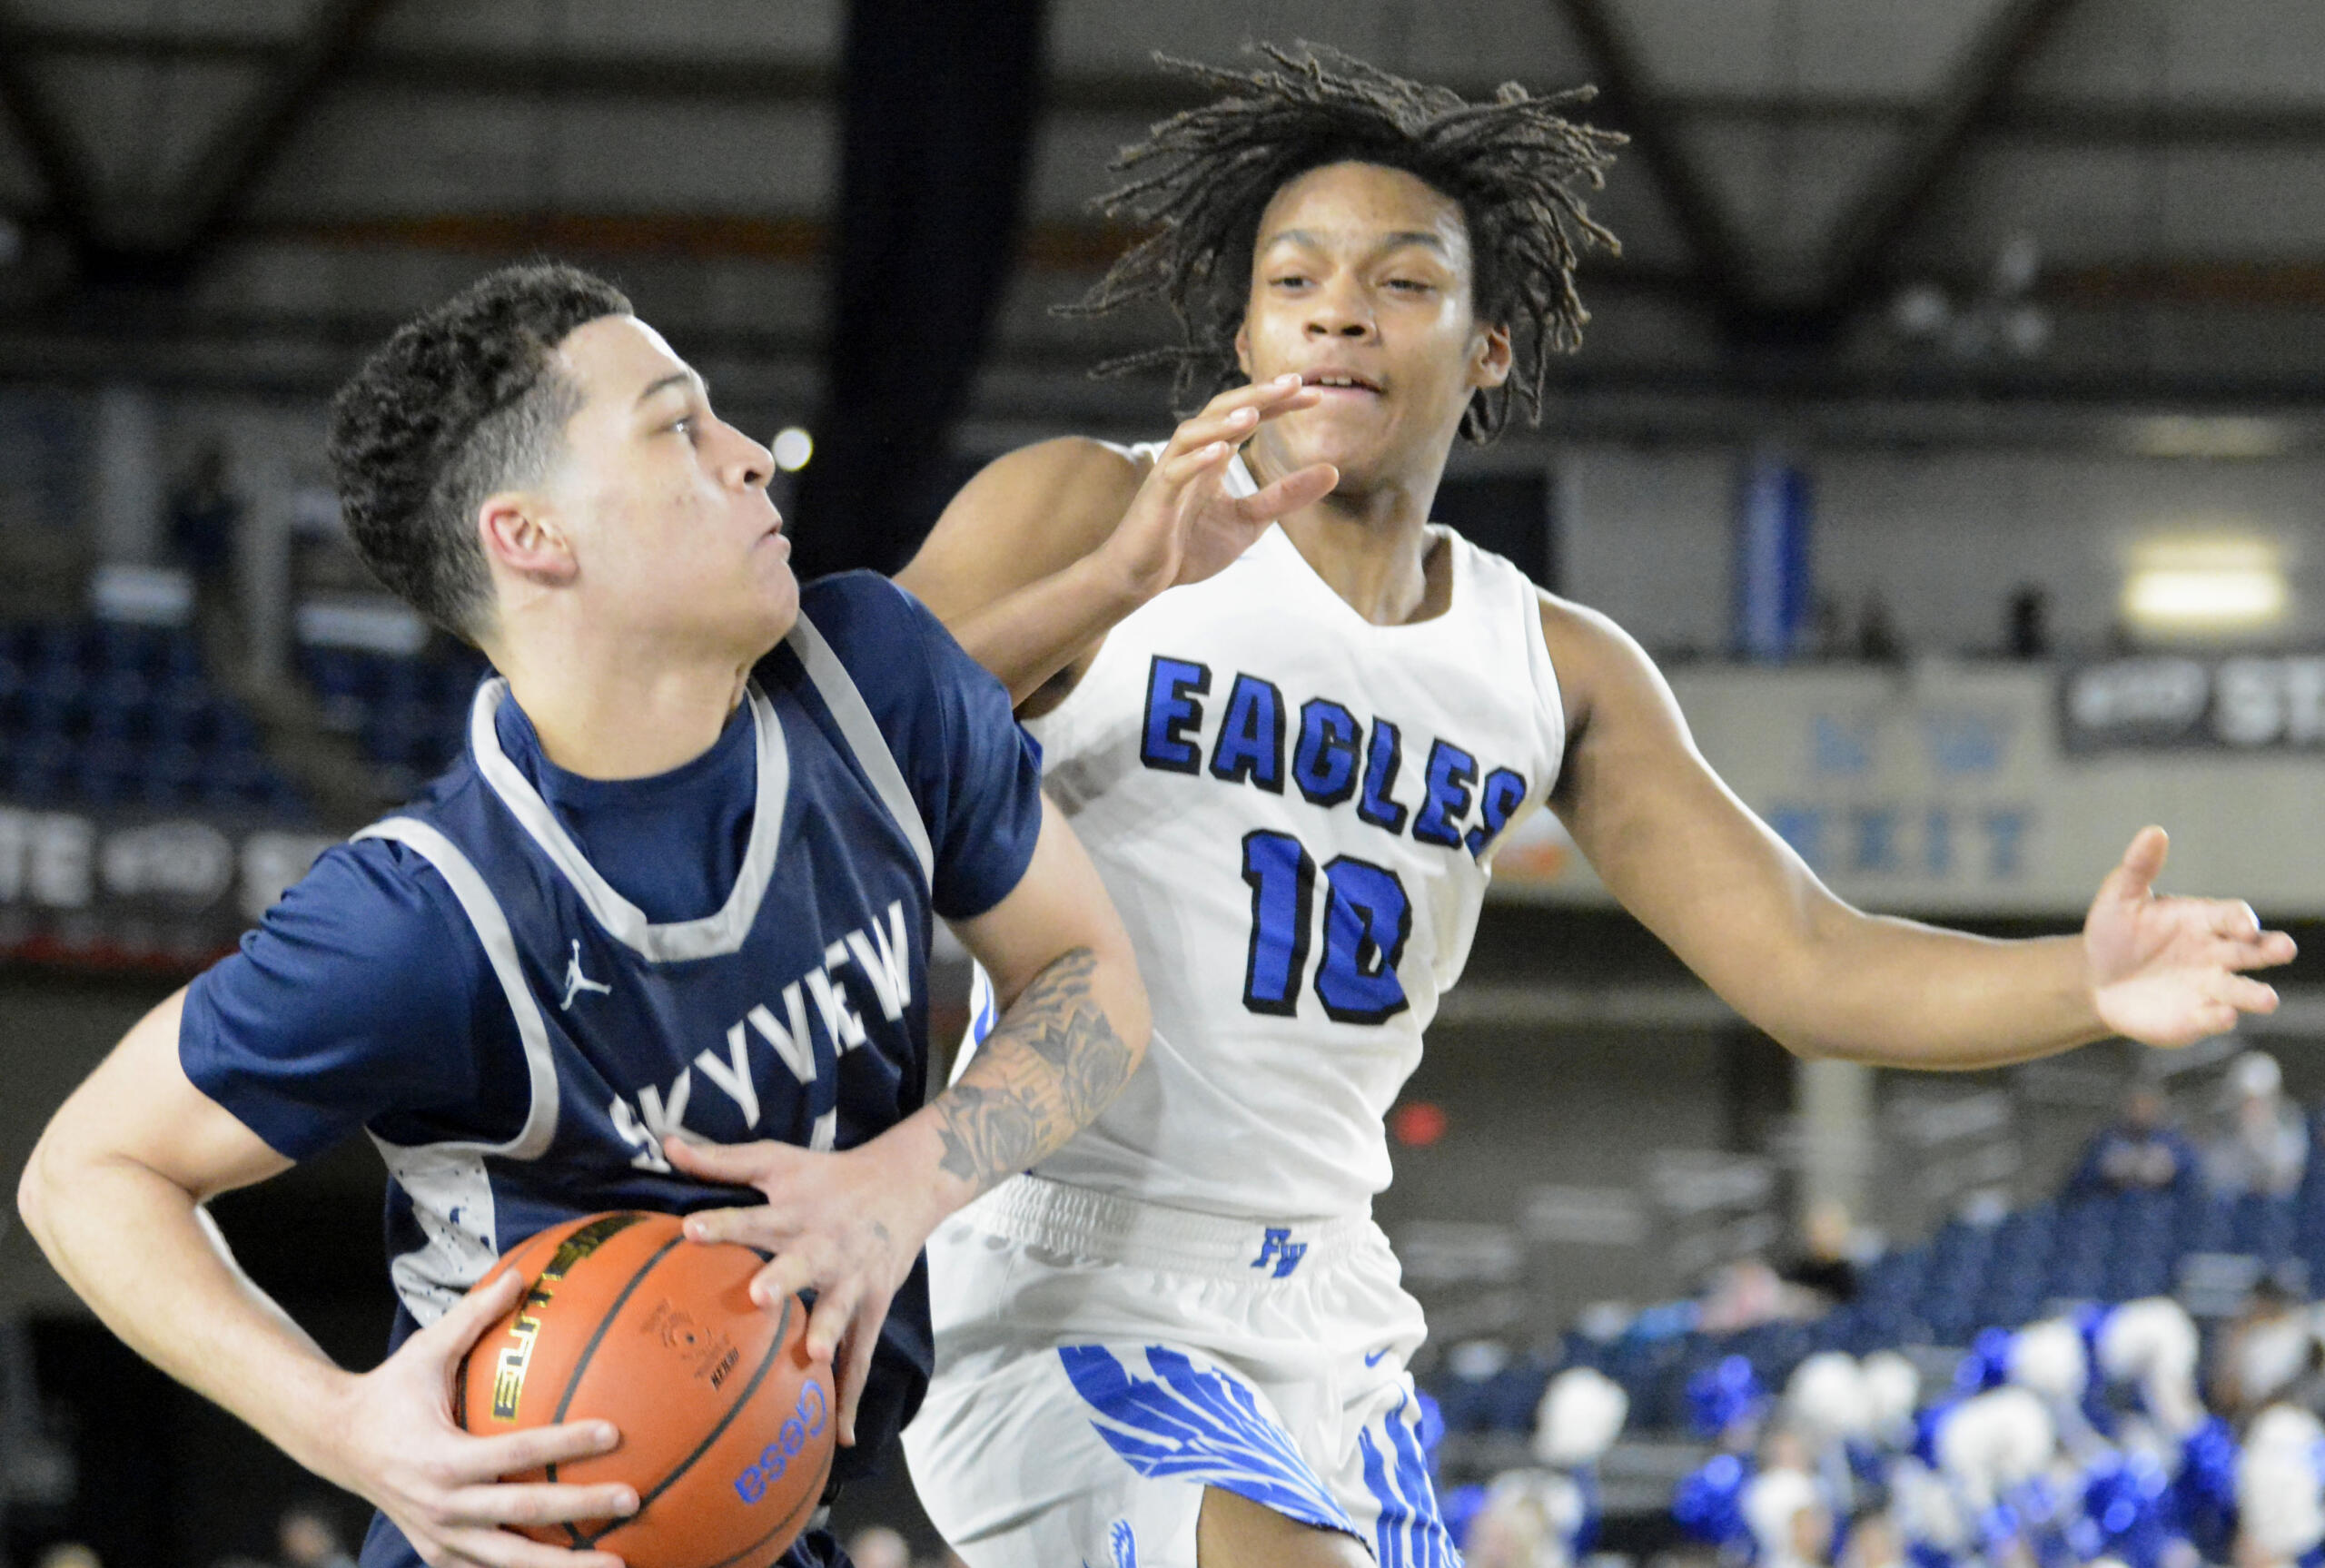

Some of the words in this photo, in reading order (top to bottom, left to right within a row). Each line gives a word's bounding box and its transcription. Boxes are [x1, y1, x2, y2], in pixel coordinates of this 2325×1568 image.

[1140, 655, 1528, 865] EAGLES
[1242, 828, 1413, 1026] 10
[734, 1379, 827, 1506] Gesa
